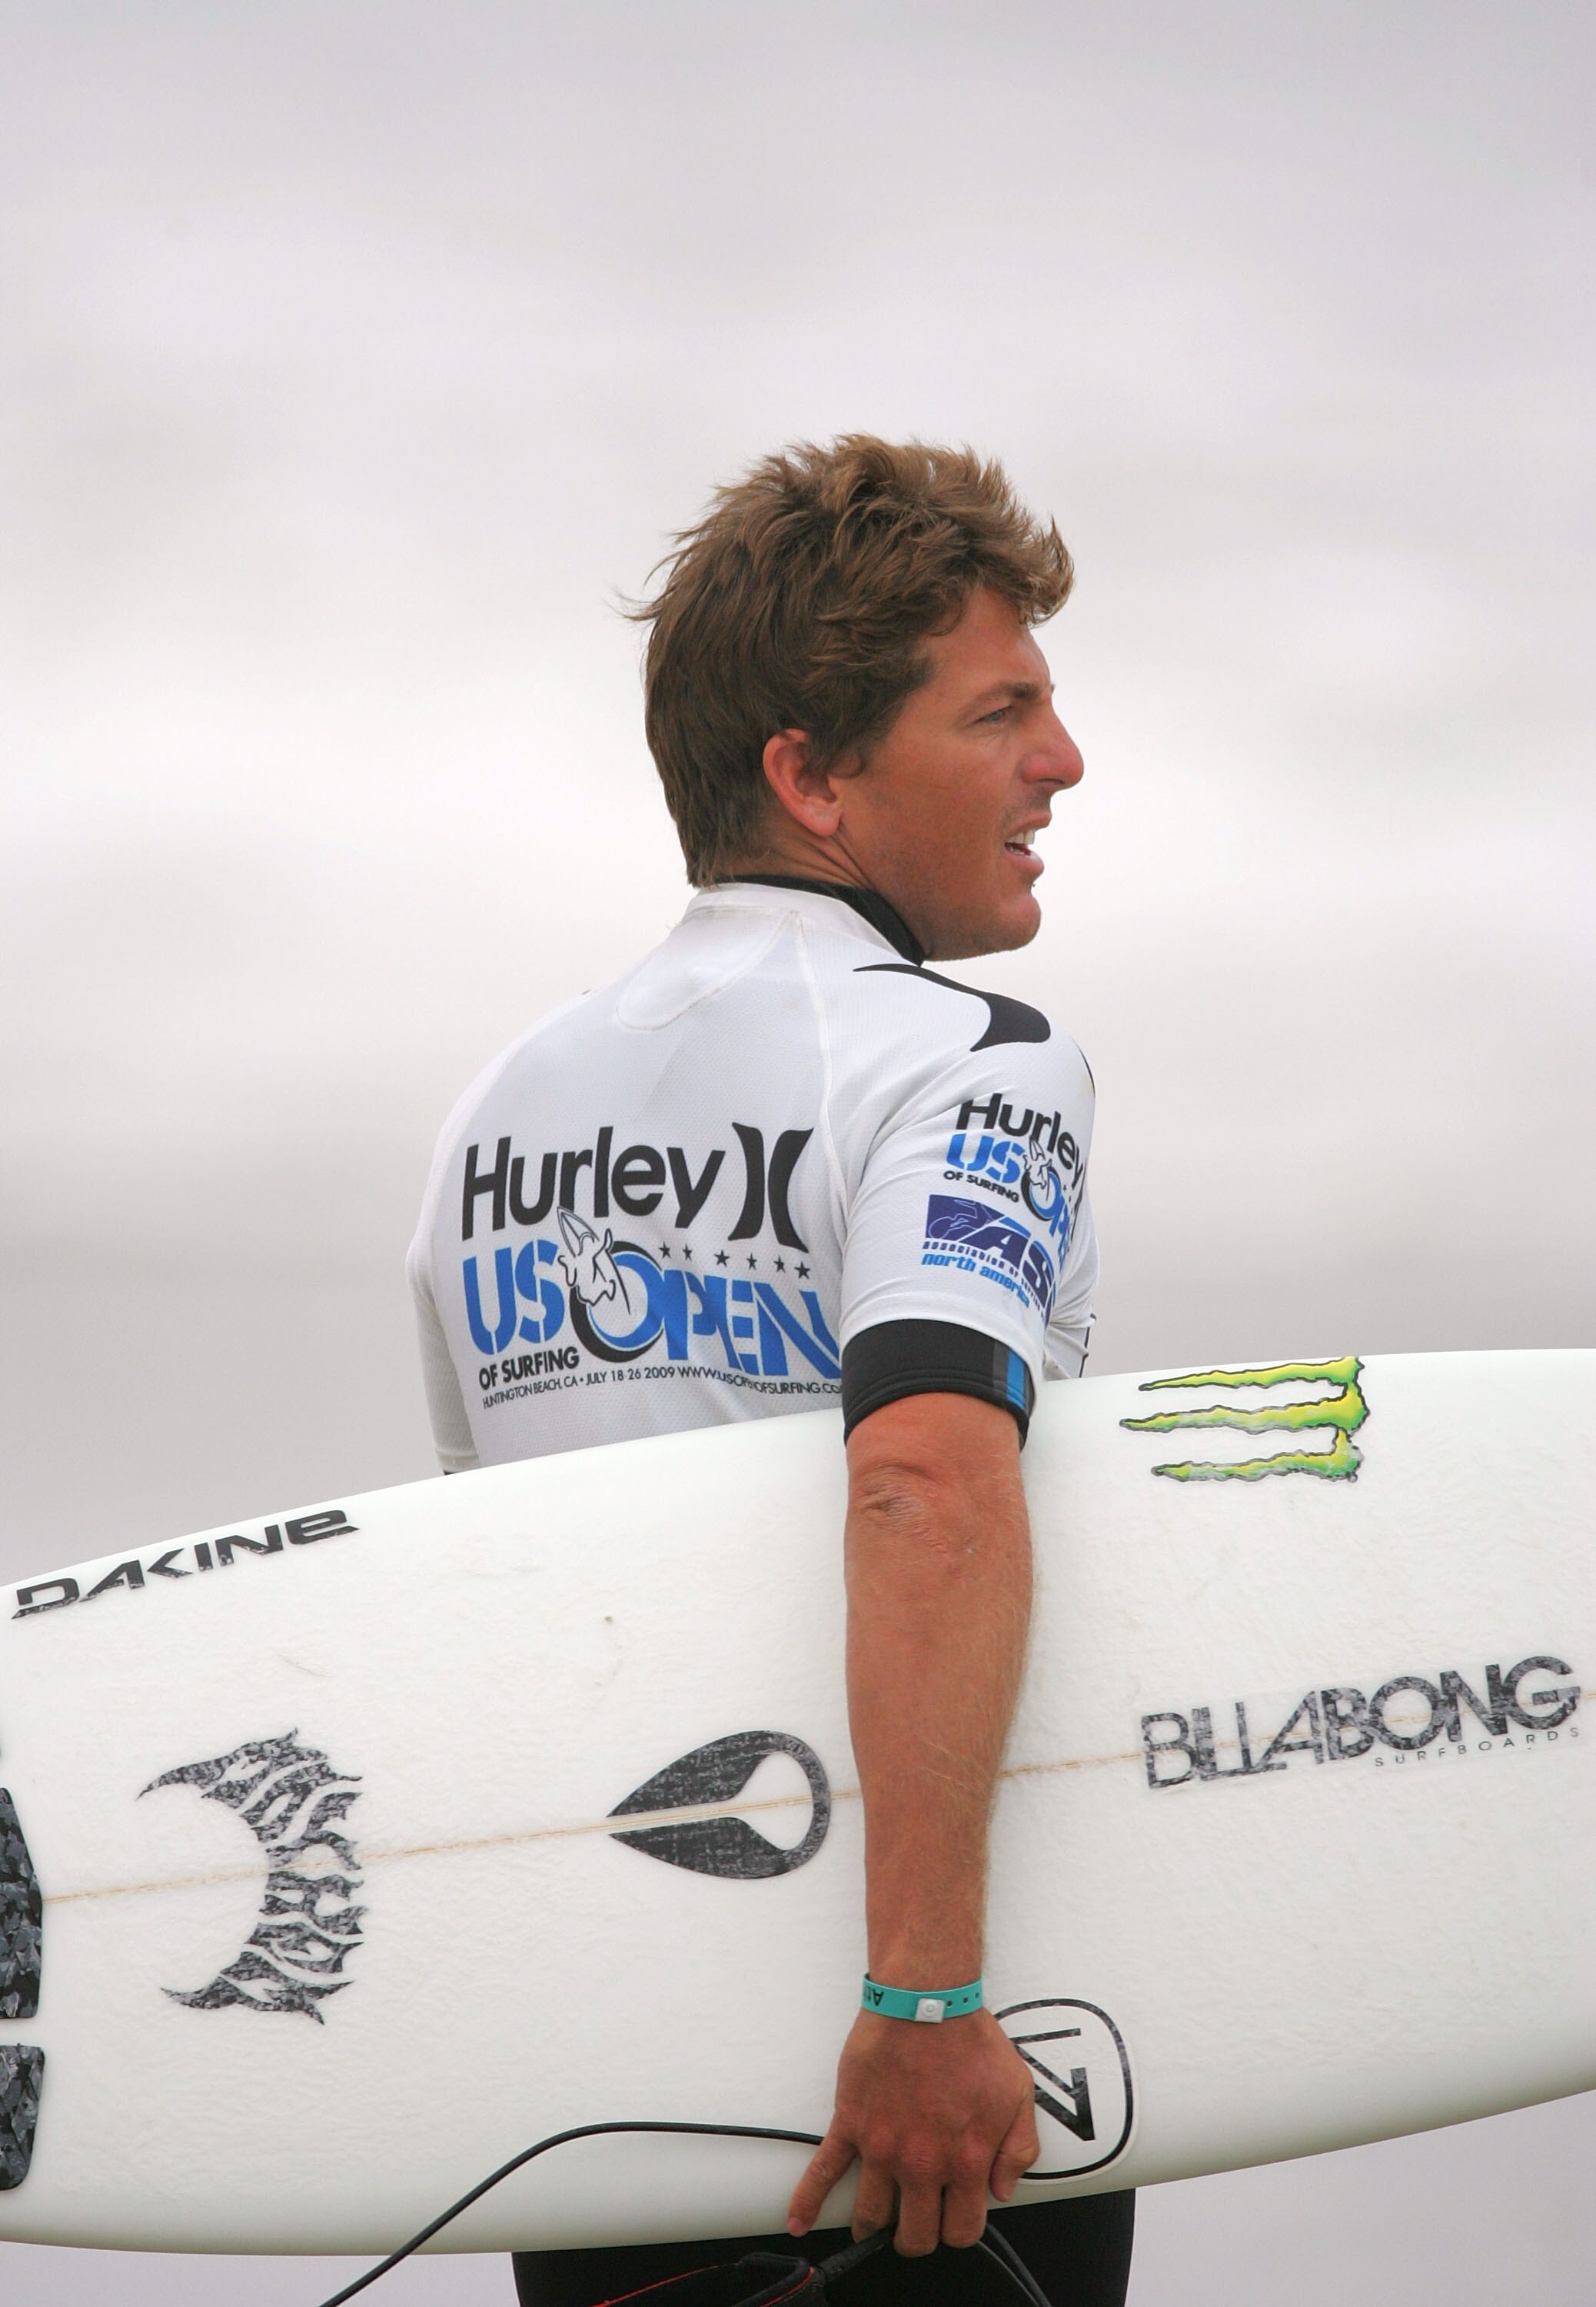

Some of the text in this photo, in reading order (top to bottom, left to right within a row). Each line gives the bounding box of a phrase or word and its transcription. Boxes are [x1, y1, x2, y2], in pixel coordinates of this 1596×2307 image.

[946, 1133, 1026, 1184] US
[956, 1093, 1084, 1190] Hurley
[462, 1126, 726, 1241] Hurley
[943, 1170, 1020, 1203] OF SURFING
[922, 1253, 977, 1272] north
[463, 1239, 842, 1380] US OPEN
[479, 1347, 580, 1390] OF SURFING
[482, 1383, 533, 1410] HUNTINGTON
[564, 1376, 578, 1388] CA
[585, 1372, 607, 1387] JULY
[644, 1367, 675, 1379] 2009
[12, 1510, 360, 1620] DAKINE
[1141, 1656, 1581, 1789] BILLABONG
[1375, 1726, 1581, 1768] SURFBOARDS
